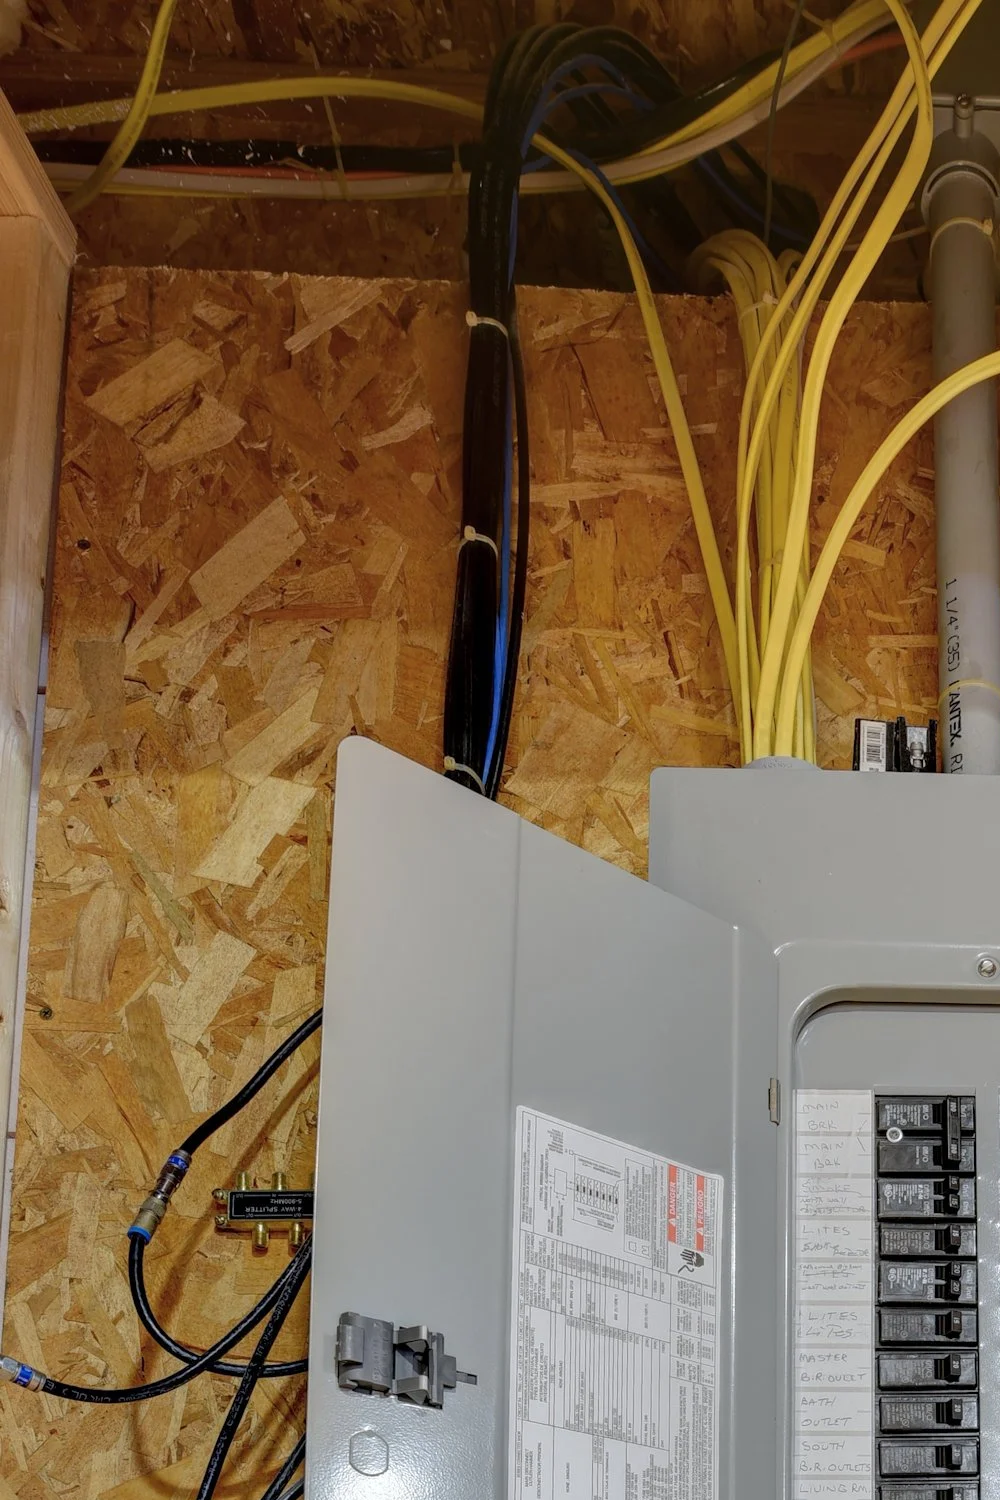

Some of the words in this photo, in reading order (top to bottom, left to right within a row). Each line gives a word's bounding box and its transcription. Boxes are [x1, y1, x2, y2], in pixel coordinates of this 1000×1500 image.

[799, 1352, 848, 1363] MASTER
[801, 1396, 837, 1407] BATH
[801, 1417, 852, 1427] OUTLET
[801, 1441, 846, 1450] SOUTH
[829, 1463, 871, 1472] OUTLETS
[800, 1483, 848, 1494] LIVING
